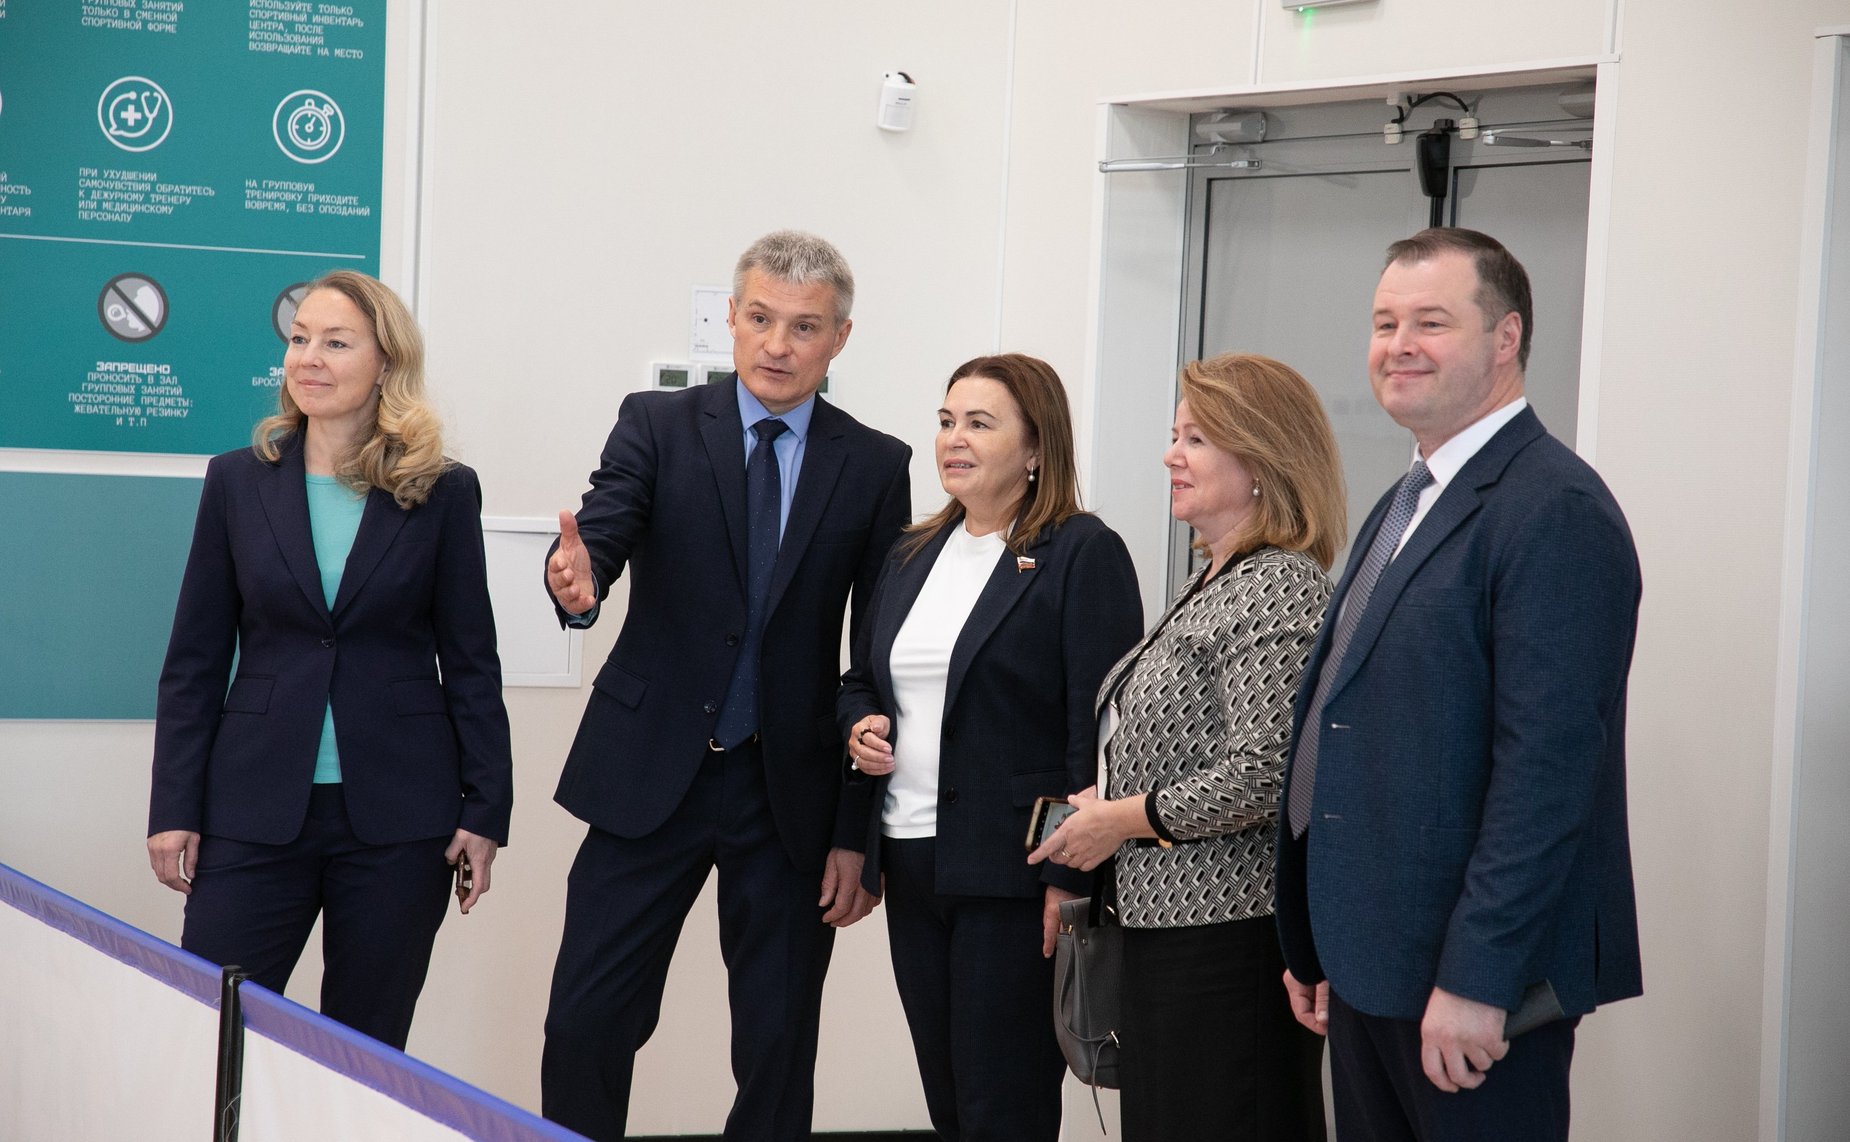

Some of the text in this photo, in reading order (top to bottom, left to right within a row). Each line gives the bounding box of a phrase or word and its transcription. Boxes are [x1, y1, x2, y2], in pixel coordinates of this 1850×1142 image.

[142, 0, 184, 12] ЗАНЯТИЙ
[249, 0, 353, 16] ИСПОЛЬЗУЙТЕ ТОЛЬКО
[82, 6, 178, 22] ТОЛЬКО В СМЕННОЙ
[249, 9, 364, 27] СПОРТИВНЫЙ ИНВЕНТАРЬ
[81, 17, 177, 34] СПОРТИВНОЙ ФОРМЕ
[249, 20, 324, 34] ЦЕНТРА, ПОСЛЕ
[249, 31, 324, 45] ИСПОЛЬЗОВАНИЯ
[249, 41, 364, 59] ВОЗВРАЩАЙТЕ НА МЕСТО
[79, 167, 157, 182] ПРИ УХУДШЕНИИ
[79, 178, 215, 197] САМОЧУВСТВИЯ ОБРАТИТЕСЬ
[245, 179, 315, 192] НА ГРУППОВУЮ
[79, 189, 192, 205] К ДЕЖУРНОМУ ТРЕНЕРУ
[245, 190, 359, 206] ТРЕНИРОВКУ ПРИХОДИТЕ
[78, 200, 174, 215] ИЛИ МЕДИЦИНСКОМУ
[245, 200, 370, 217] ВОВРЕМЯ, БЕЗ ОПОЗДАНИЙ
[78, 210, 132, 223] ПЕРСОНАЛУ
[96, 361, 171, 374] ЗАПРЕЩЕНО
[87, 372, 178, 385] ПРОНОСИТЬ В ЗАЛ
[81, 382, 183, 396] ГРУППОВЫХ ЗАНЯТИЙ
[68, 393, 193, 408] ПОСТОРОННИЕ ПРЕДМЕТЫ:
[74, 404, 189, 418] ЖЕВАТЕЛЬНУЮ РЕЗИНКУ
[116, 417, 147, 427] И Т.П
